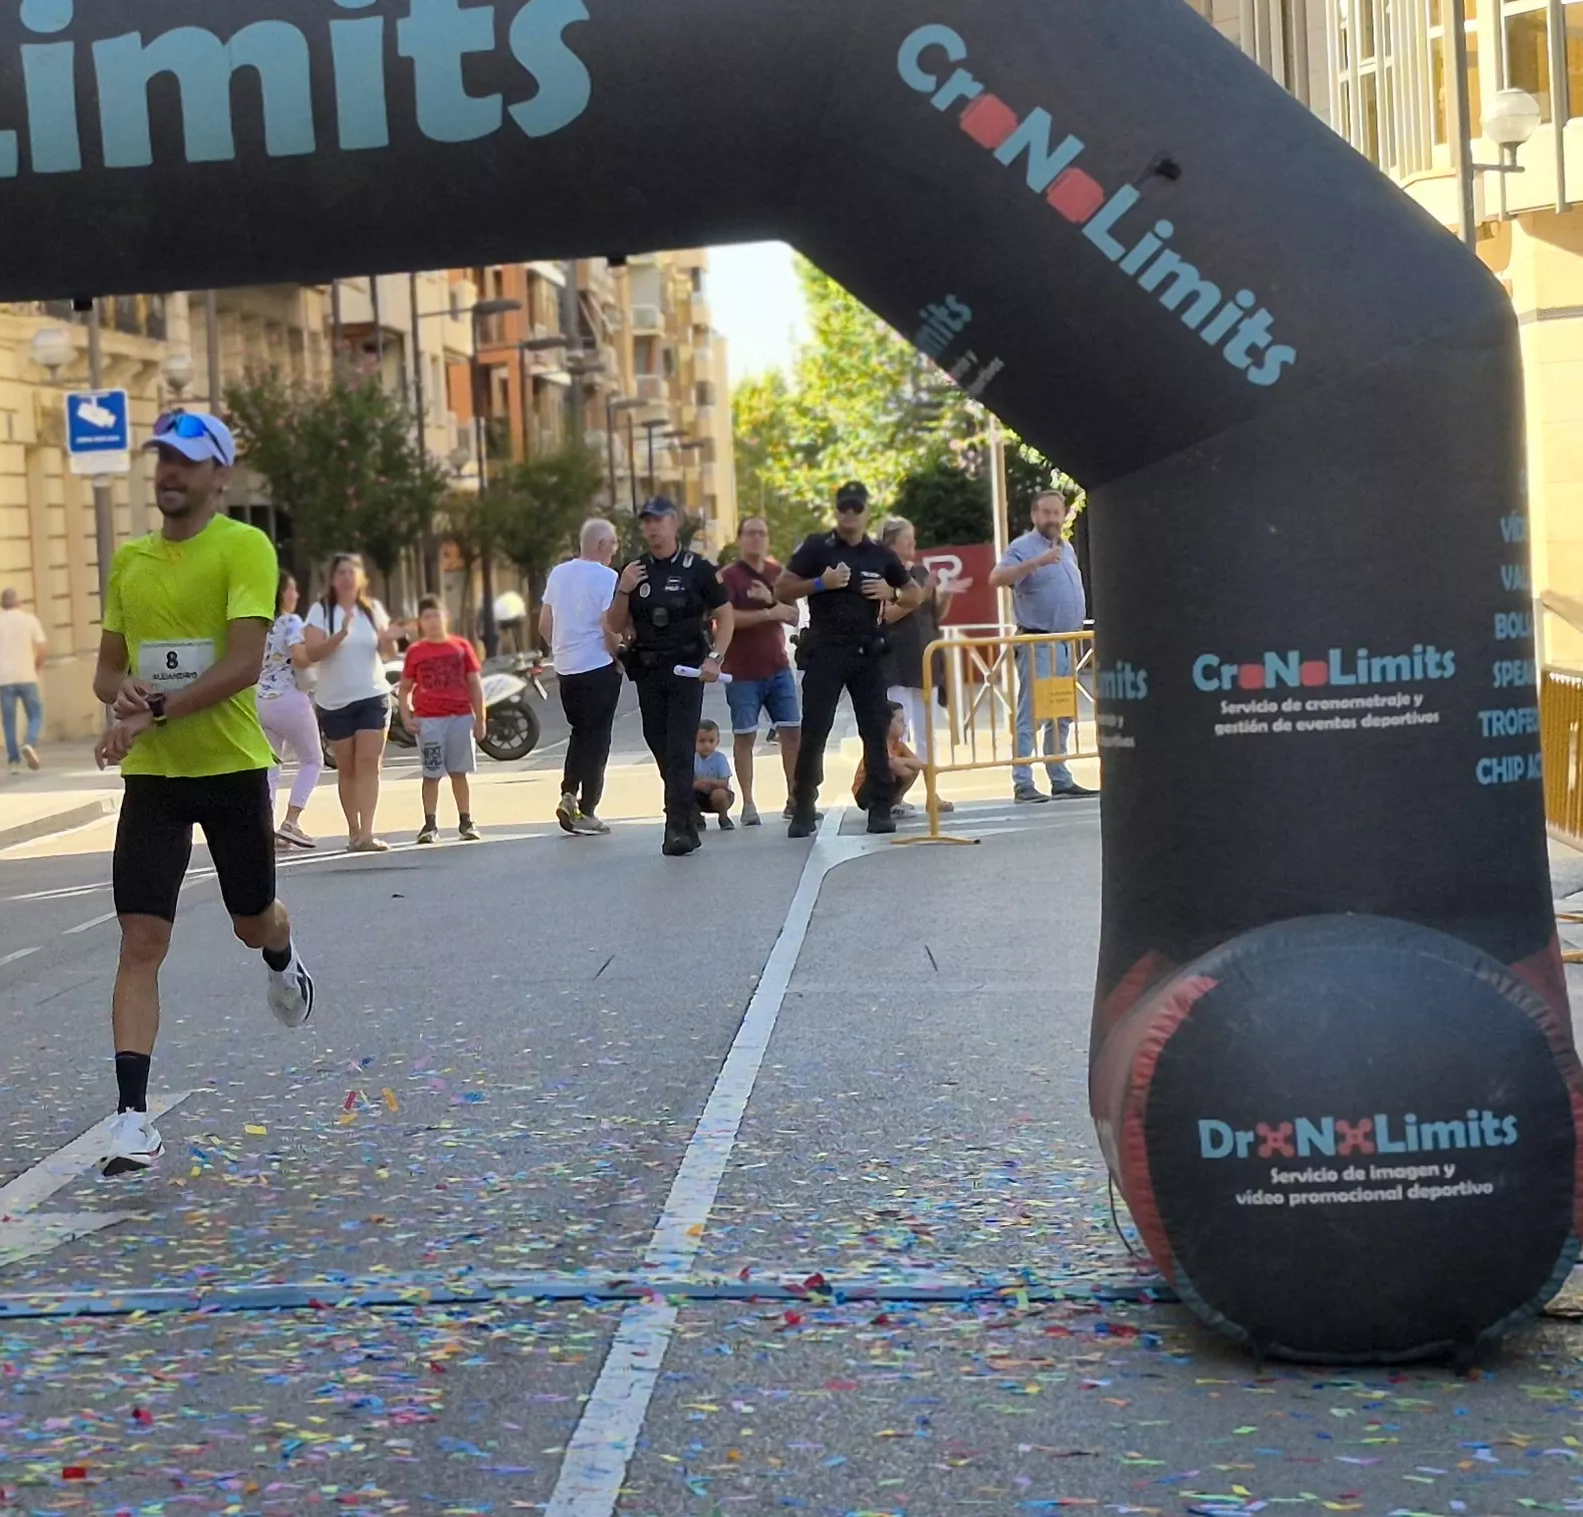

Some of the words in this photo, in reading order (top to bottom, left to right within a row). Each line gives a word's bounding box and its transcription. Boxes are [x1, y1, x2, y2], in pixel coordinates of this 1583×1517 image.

[165, 650, 179, 669] 8
[1221, 699, 1278, 715] Servicio
[1281, 698, 1302, 712] de
[1305, 692, 1411, 712] cronometraje
[1413, 693, 1424, 708] y
[1214, 717, 1268, 736] gestión
[1272, 716, 1292, 732] de
[1295, 714, 1357, 732] eventos
[1360, 711, 1440, 729] deportivos
[1270, 1167, 1339, 1185] Servicio
[1342, 1164, 1366, 1181] de
[1369, 1163, 1440, 1182] imagen
[1443, 1163, 1456, 1179] y
[1235, 1189, 1285, 1206] vídeo
[1288, 1183, 1403, 1208] promocional
[1407, 1180, 1494, 1201] deportivo
